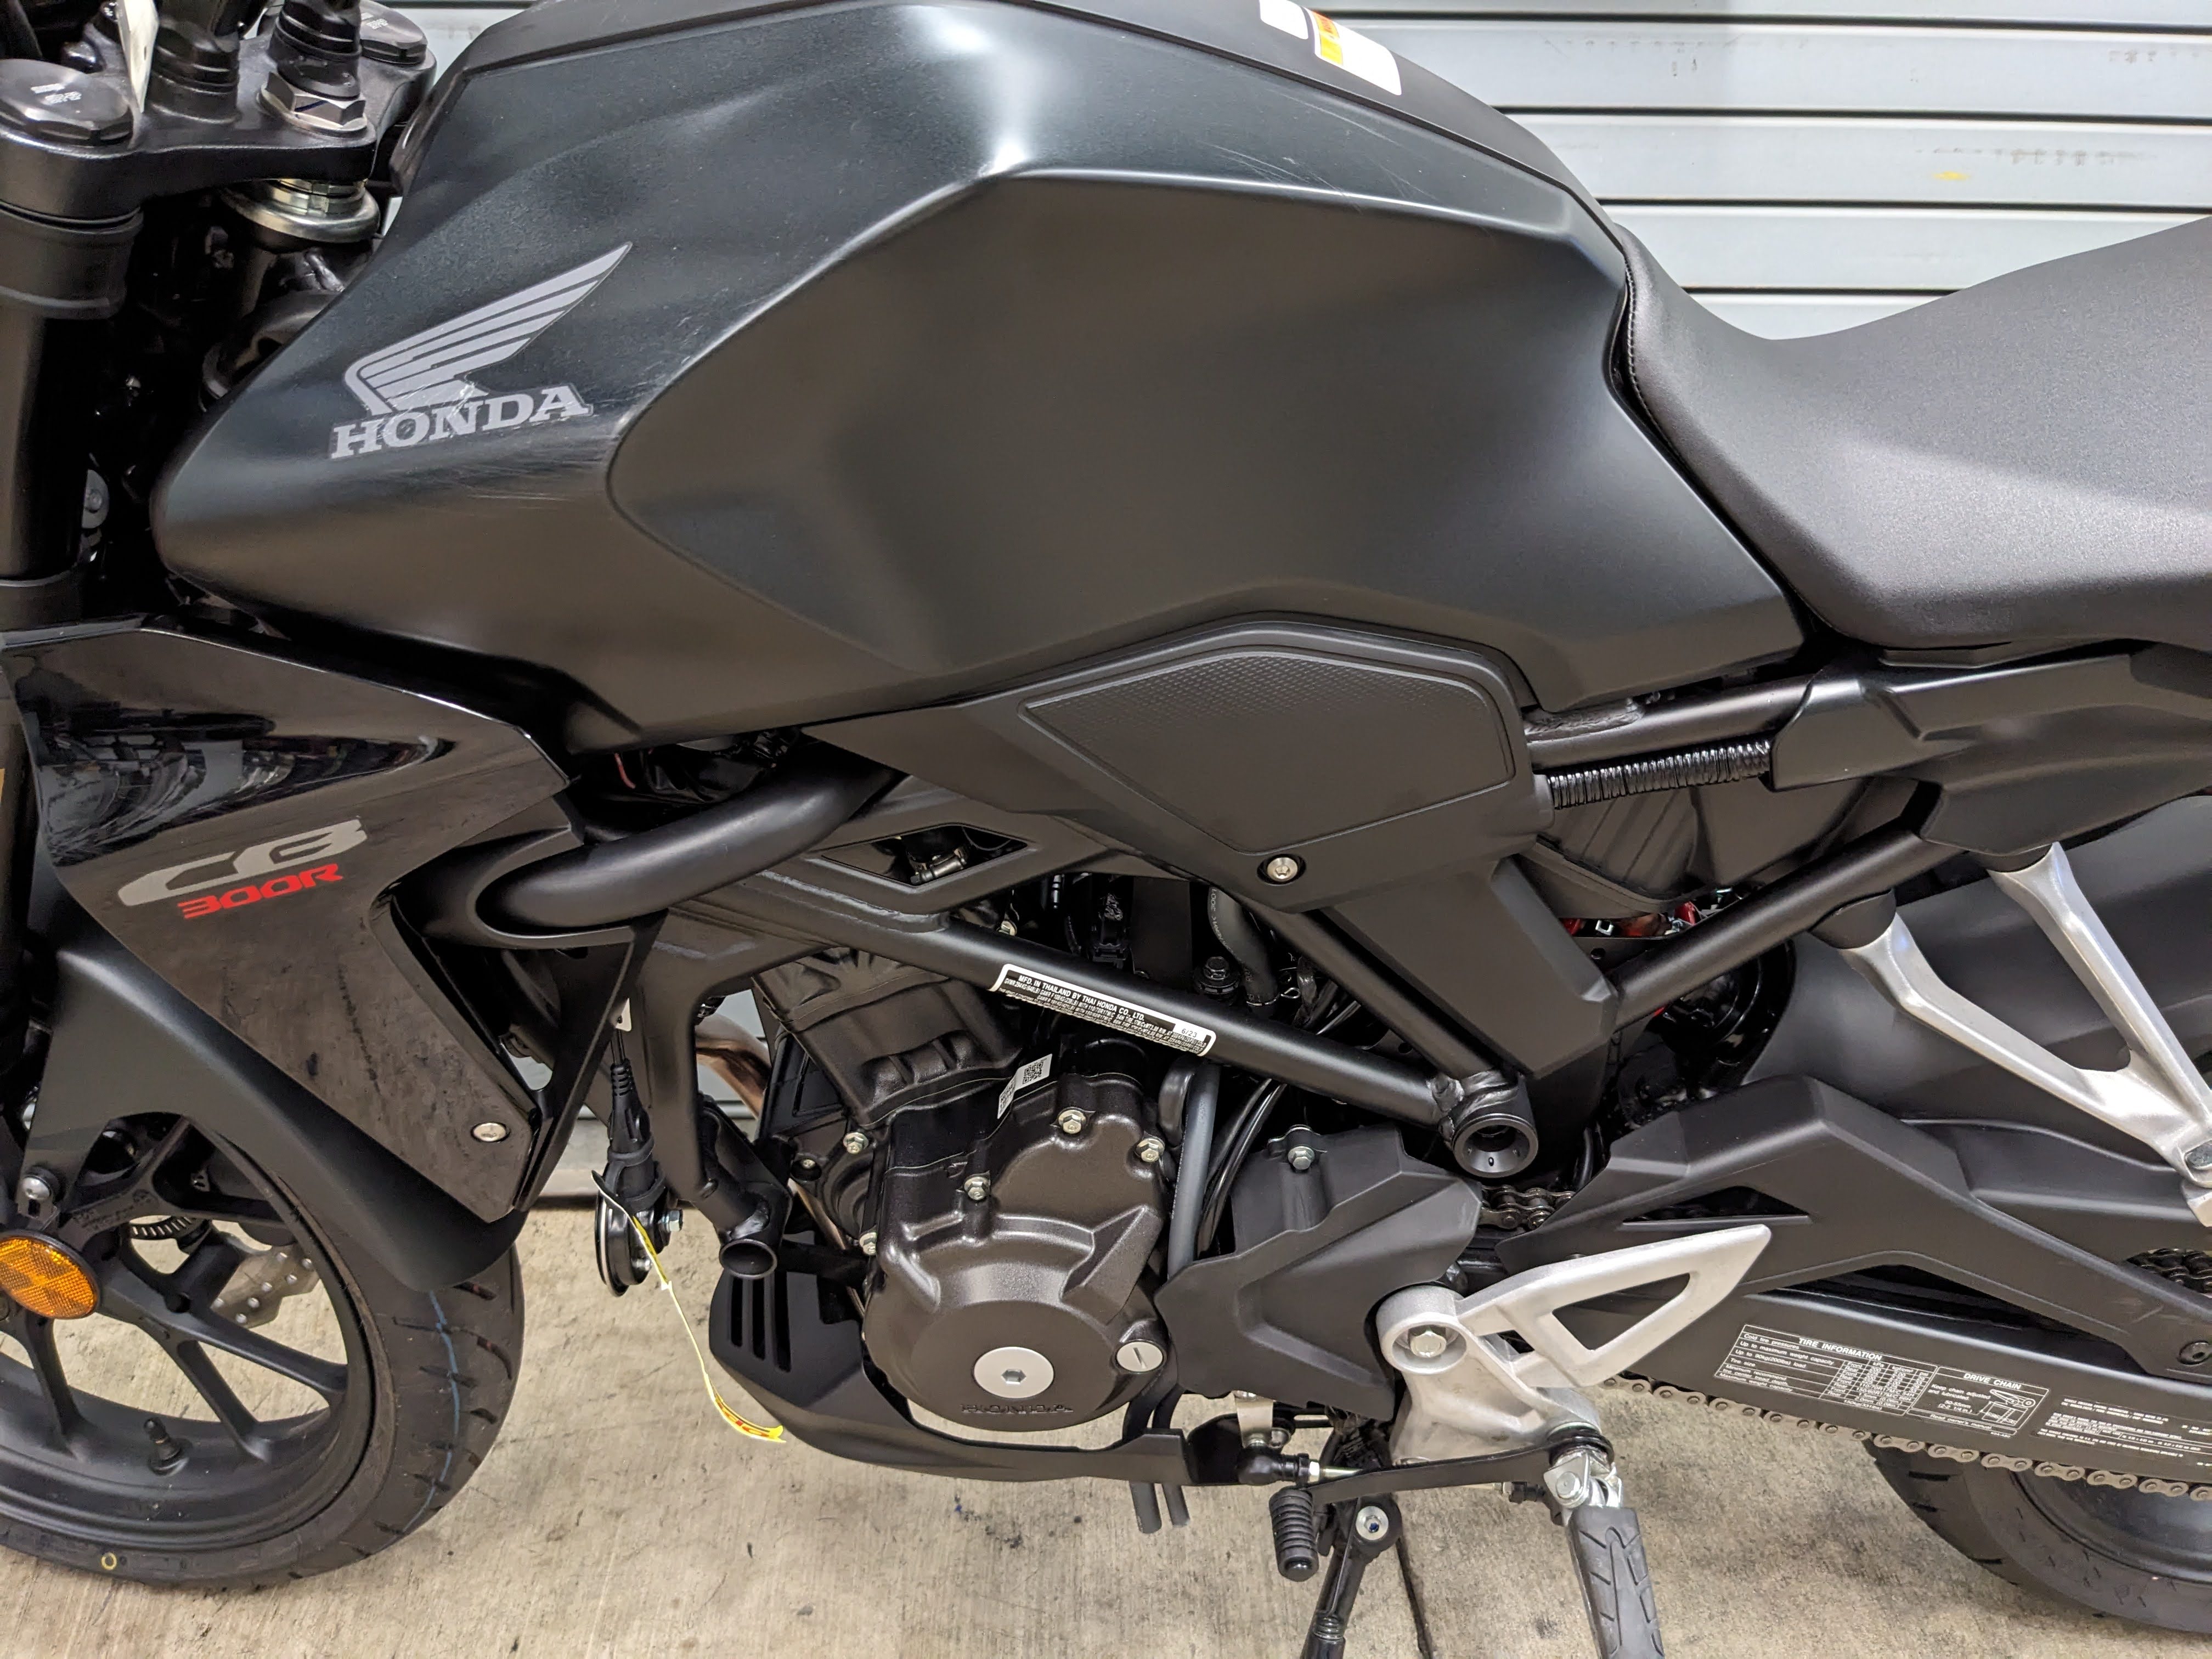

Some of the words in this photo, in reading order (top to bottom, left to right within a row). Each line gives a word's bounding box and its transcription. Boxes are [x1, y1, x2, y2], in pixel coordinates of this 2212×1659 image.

[331, 385, 589, 459] HONDA
[118, 819, 368, 906] CB
[177, 863, 343, 919] 300R
[1019, 975, 1033, 986] MFD.
[1034, 979, 1041, 988] IN
[1042, 982, 1071, 997] THAILAND
[1073, 991, 1081, 1000] BY
[1082, 994, 1096, 1005] THAI
[1097, 999, 1117, 1012] HONDA
[1132, 1011, 1144, 1020] LTD.
[1181, 1028, 1198, 1037] 6/23
[1770, 1340, 1800, 1350] pressures
[1796, 1338, 1820, 1347] TIRE
[1820, 1343, 1883, 1361] INFORMATION
[1753, 1353, 1792, 1365] 90kg(200lbs)
[1759, 1345, 1788, 1355] maximum
[1788, 1352, 1809, 1360] weight
[1809, 1357, 1835, 1365] capacity
[1718, 1373, 1747, 1381] Maximum
[1768, 1384, 1793, 1392] capacity
[1753, 1371, 1787, 1380] recommend
[1962, 1373, 1991, 1383] DRIVE
[1993, 1379, 2022, 1390] CHAIN
[1940, 1391, 1971, 1401] lubricated.
[1965, 1391, 1991, 1400] adjusted
[960, 1404, 1074, 1414] HONDA
[1944, 1400, 1972, 1408] 50-55mm
